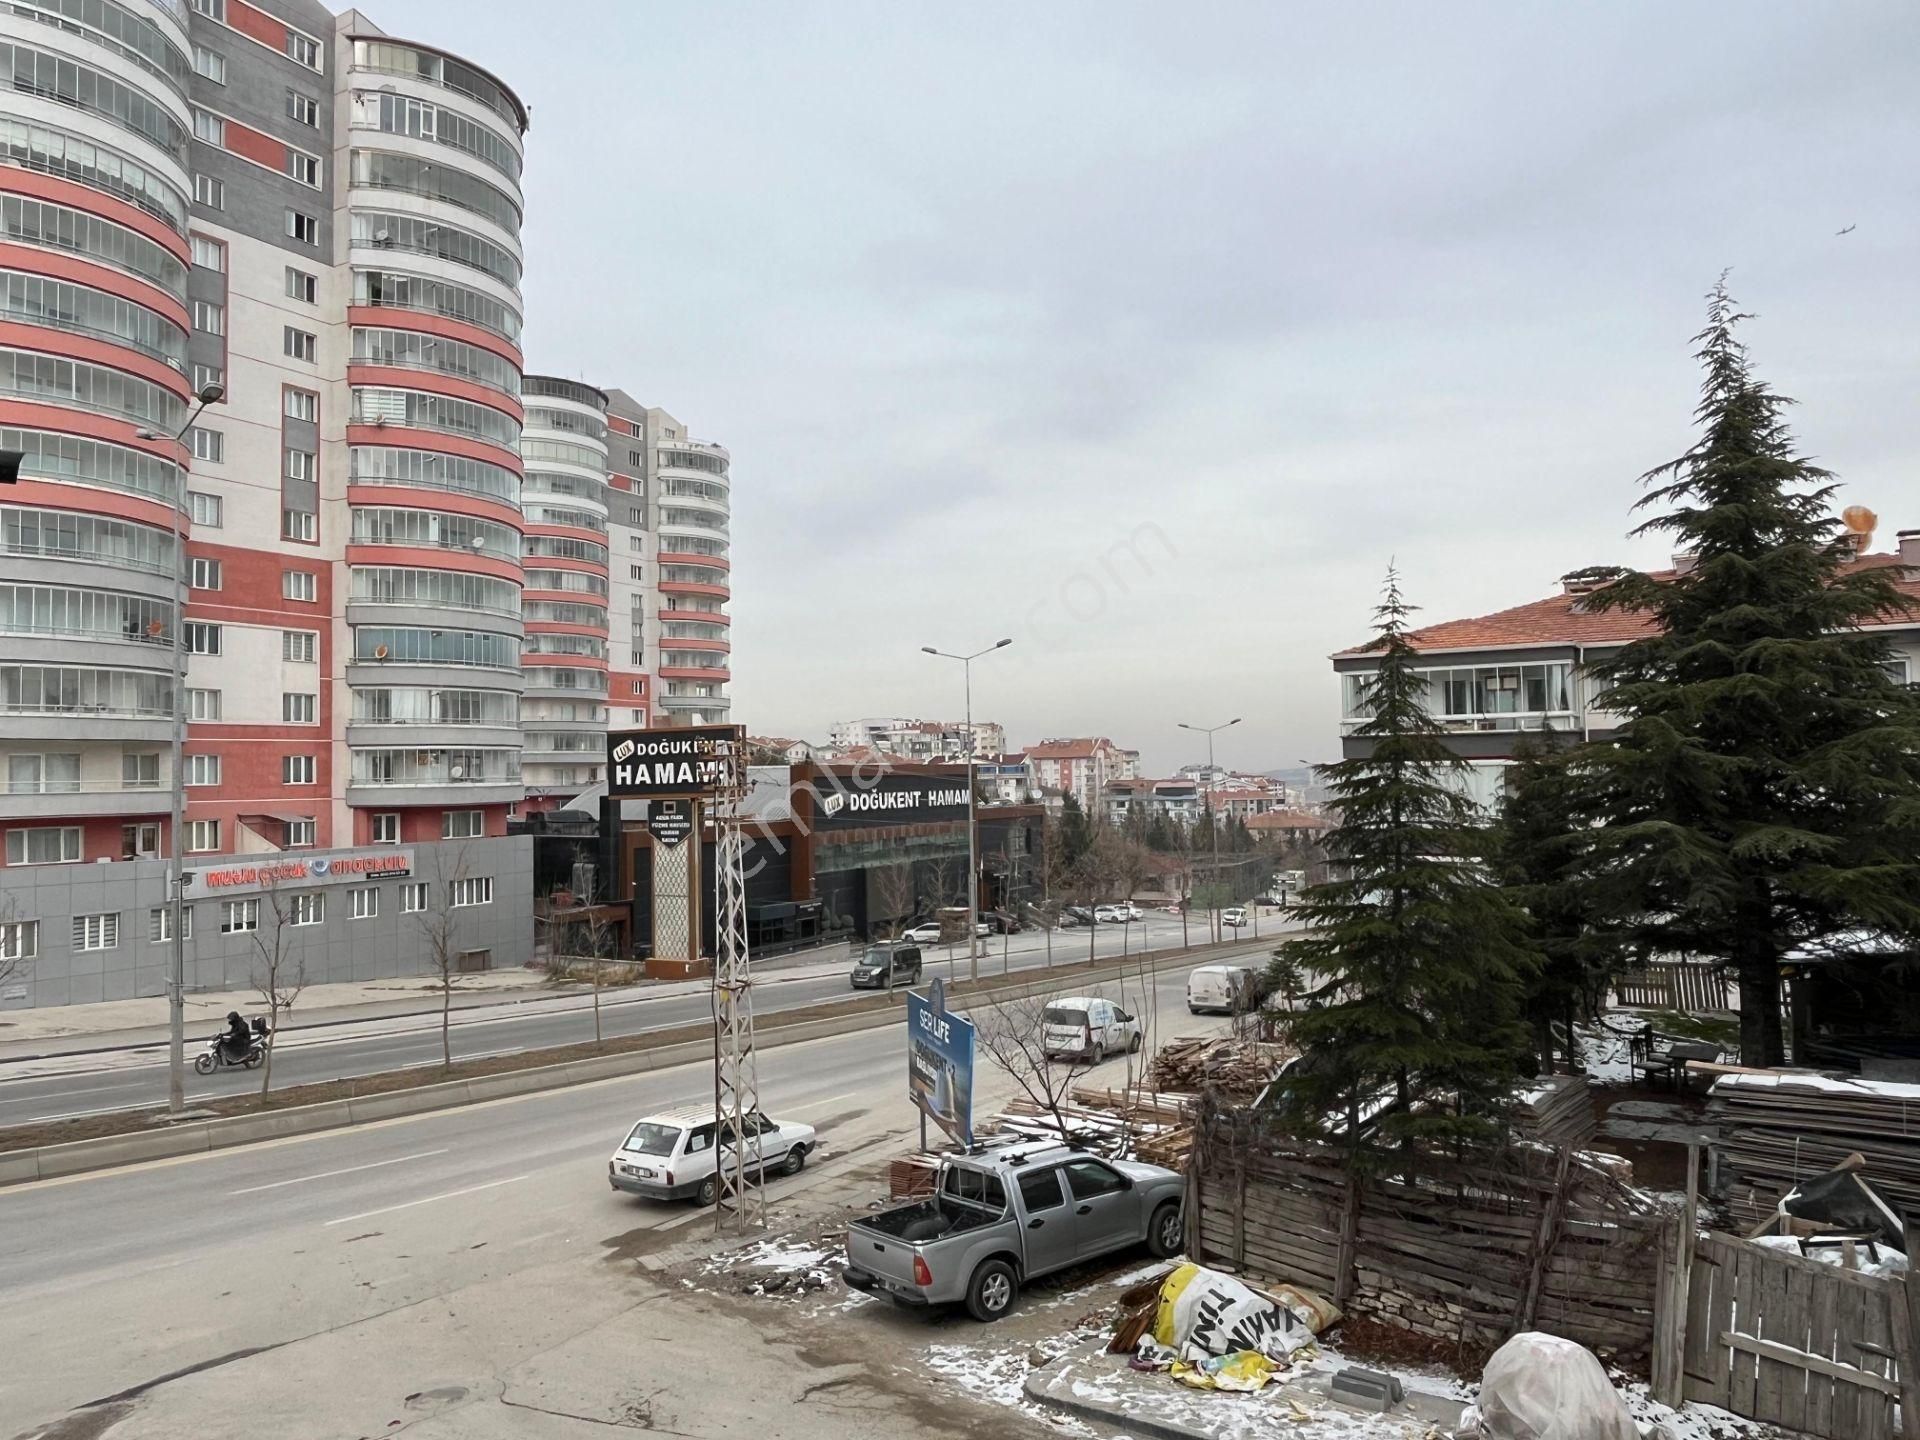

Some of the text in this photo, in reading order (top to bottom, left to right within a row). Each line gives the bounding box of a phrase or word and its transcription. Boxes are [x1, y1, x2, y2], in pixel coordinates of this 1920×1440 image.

[615, 743, 633, 760] LUX
[827, 795, 841, 812] LUX
[850, 788, 922, 811] DOĞUKENT
[933, 1015, 950, 1044] LIFE
